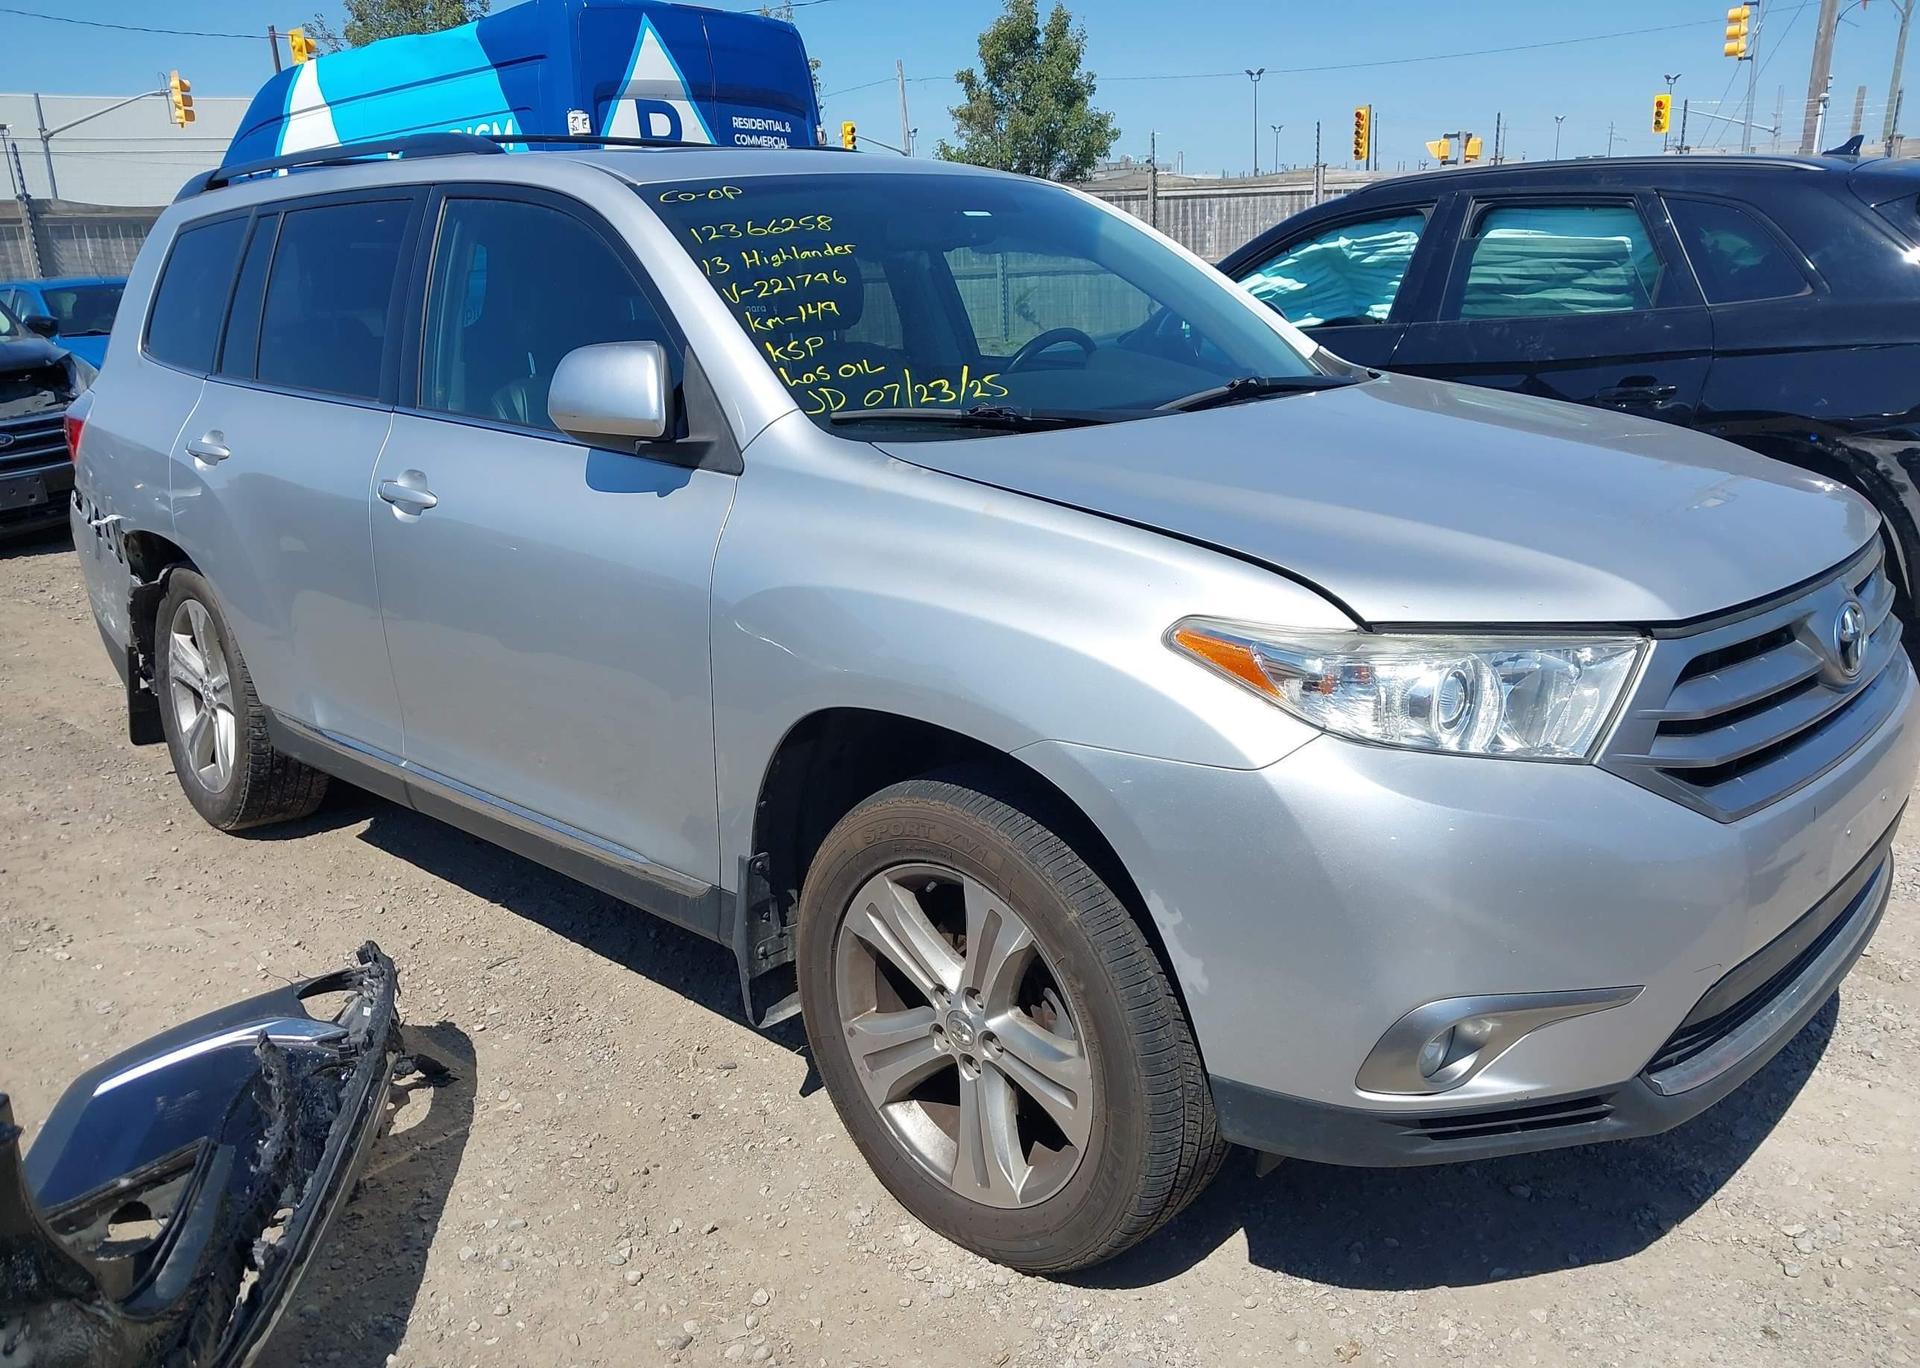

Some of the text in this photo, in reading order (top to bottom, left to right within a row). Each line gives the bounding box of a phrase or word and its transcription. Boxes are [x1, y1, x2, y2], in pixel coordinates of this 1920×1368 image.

[732, 116, 791, 133] RESIDENTIAL &
[734, 133, 789, 149] COMMERCIAL
[690, 215, 832, 244] 12366258
[702, 242, 857, 277] 13 Highlander
[722, 269, 847, 304] V-221796
[805, 365, 1010, 415] JD 07/23/25
[863, 822, 936, 845] SPORT
